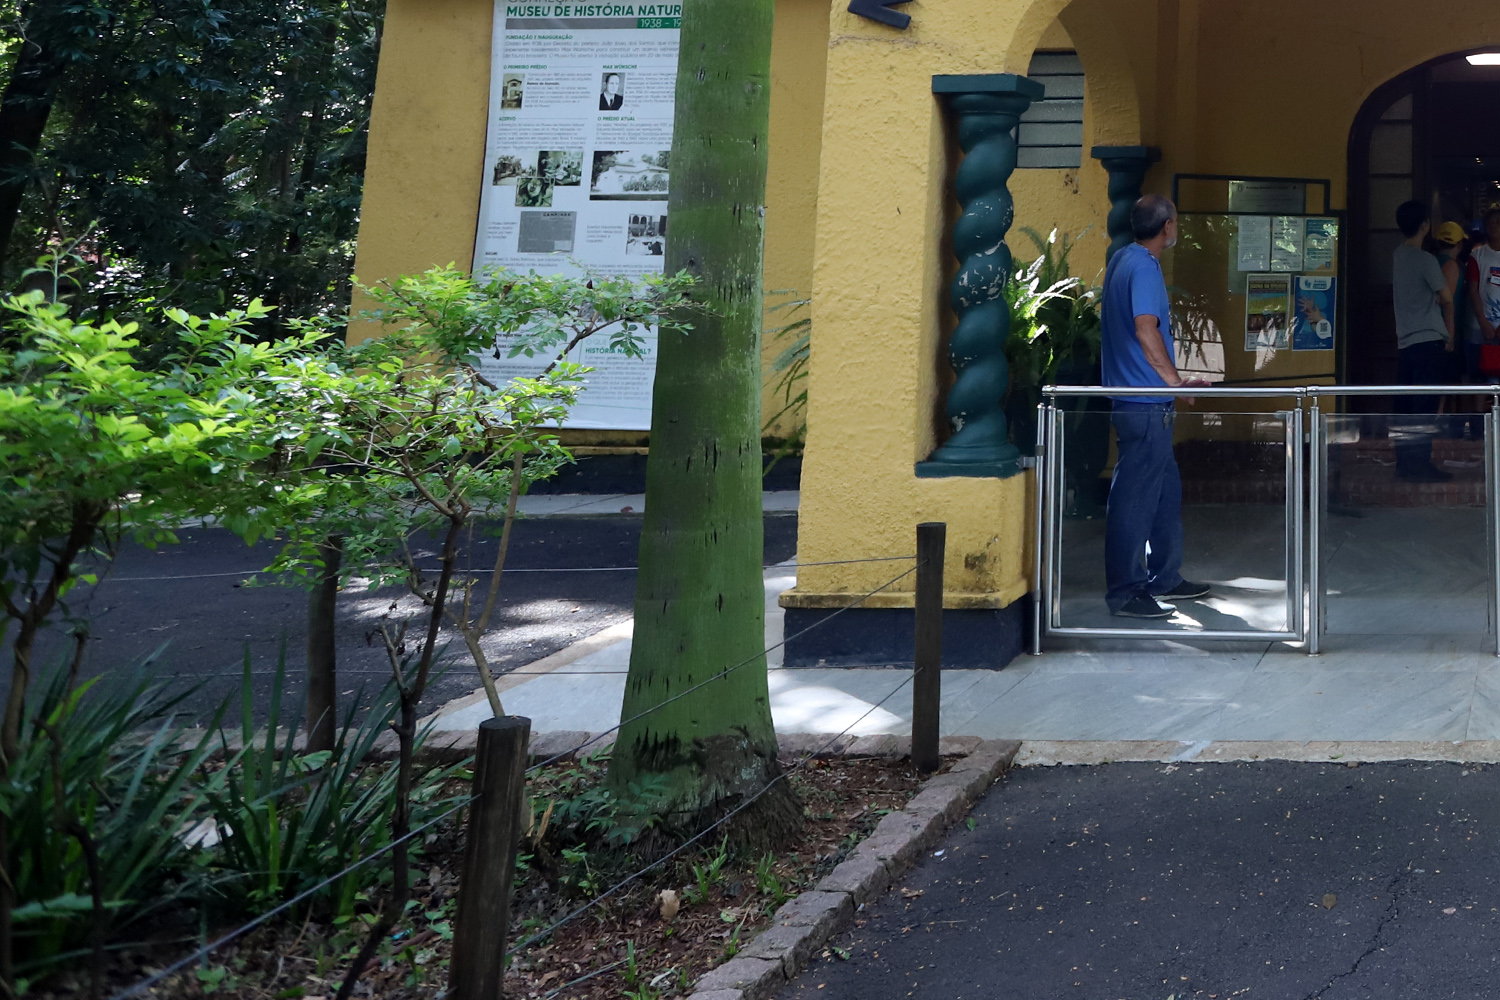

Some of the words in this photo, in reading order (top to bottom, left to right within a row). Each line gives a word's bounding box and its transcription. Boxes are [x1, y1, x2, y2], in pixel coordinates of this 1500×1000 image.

[507, 5, 550, 17] MUSEU
[554, 5, 571, 17] DE
[574, 2, 634, 16] HISTÓRIA
[638, 5, 681, 16] NATUR
[641, 18, 662, 28] 1938
[673, 18, 681, 28] 19
